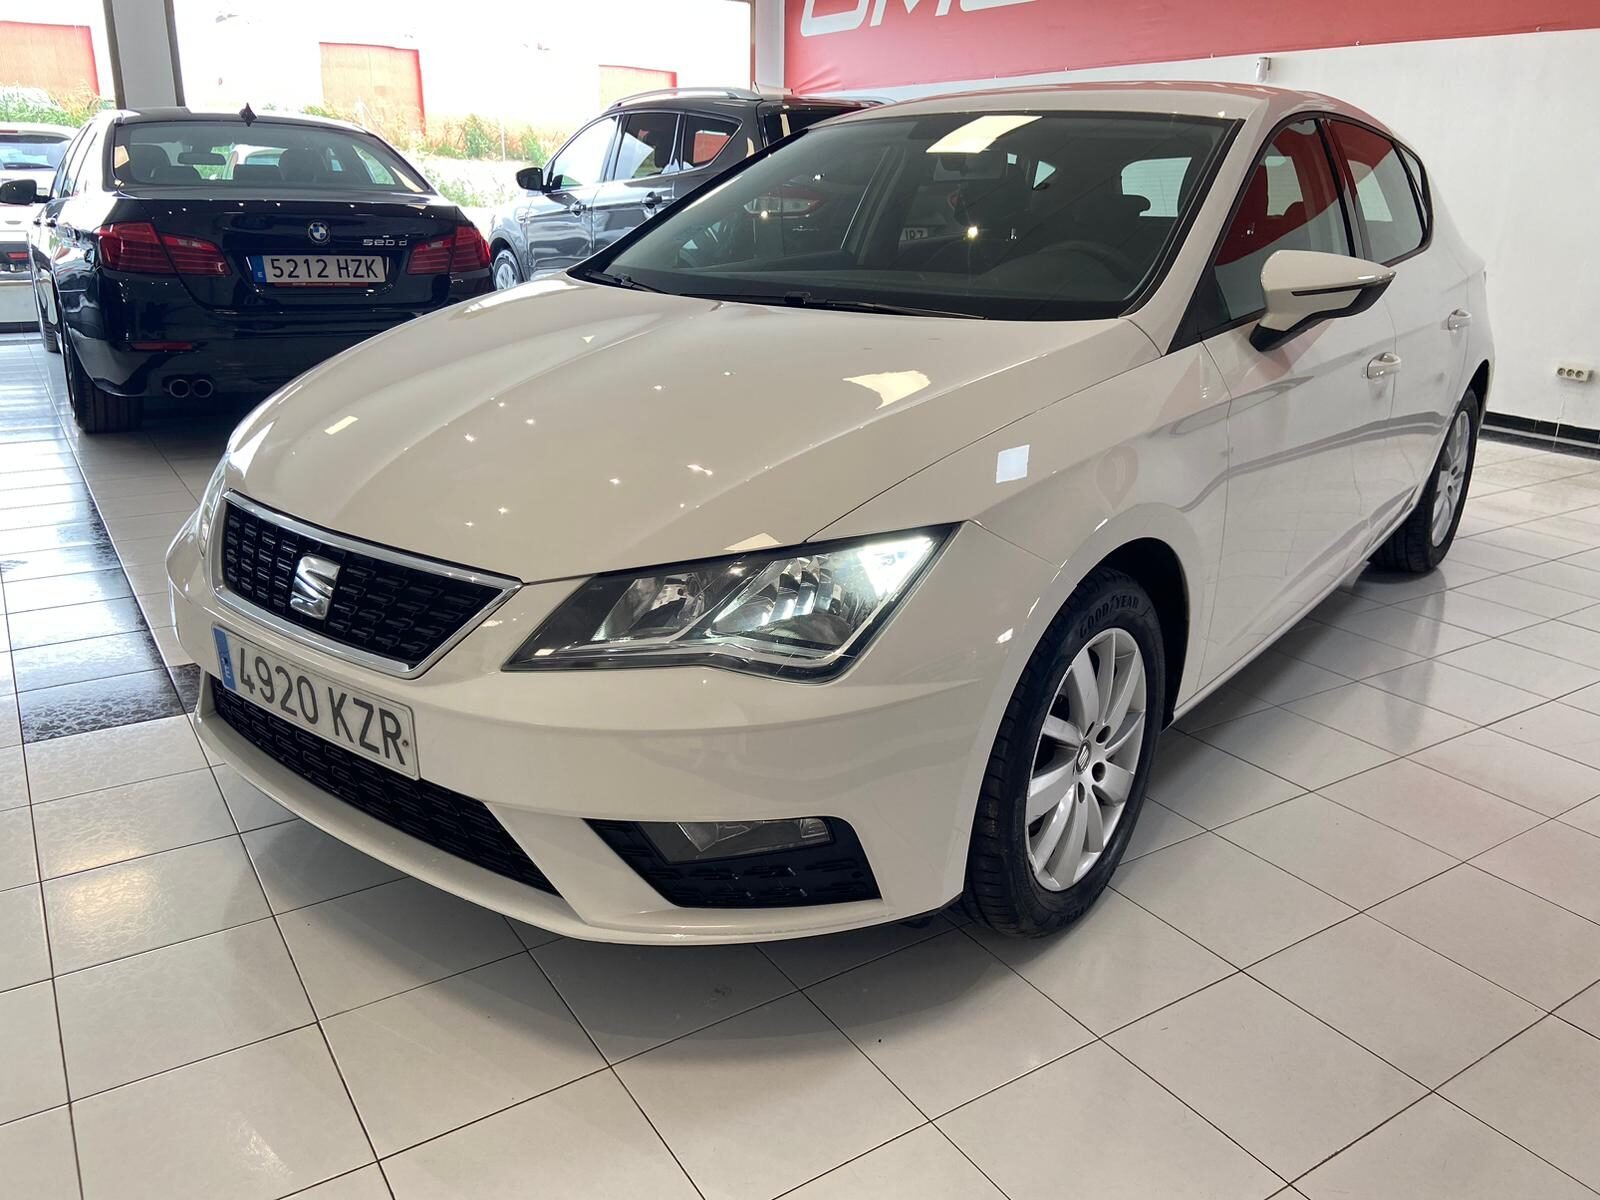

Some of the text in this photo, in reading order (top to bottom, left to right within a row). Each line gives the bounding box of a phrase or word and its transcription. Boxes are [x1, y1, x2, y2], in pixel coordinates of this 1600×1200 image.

[270, 258, 378, 279] 5212 HZK
[1080, 594, 1140, 639] GOODYEAR
[239, 647, 407, 767] 4920 KZR
